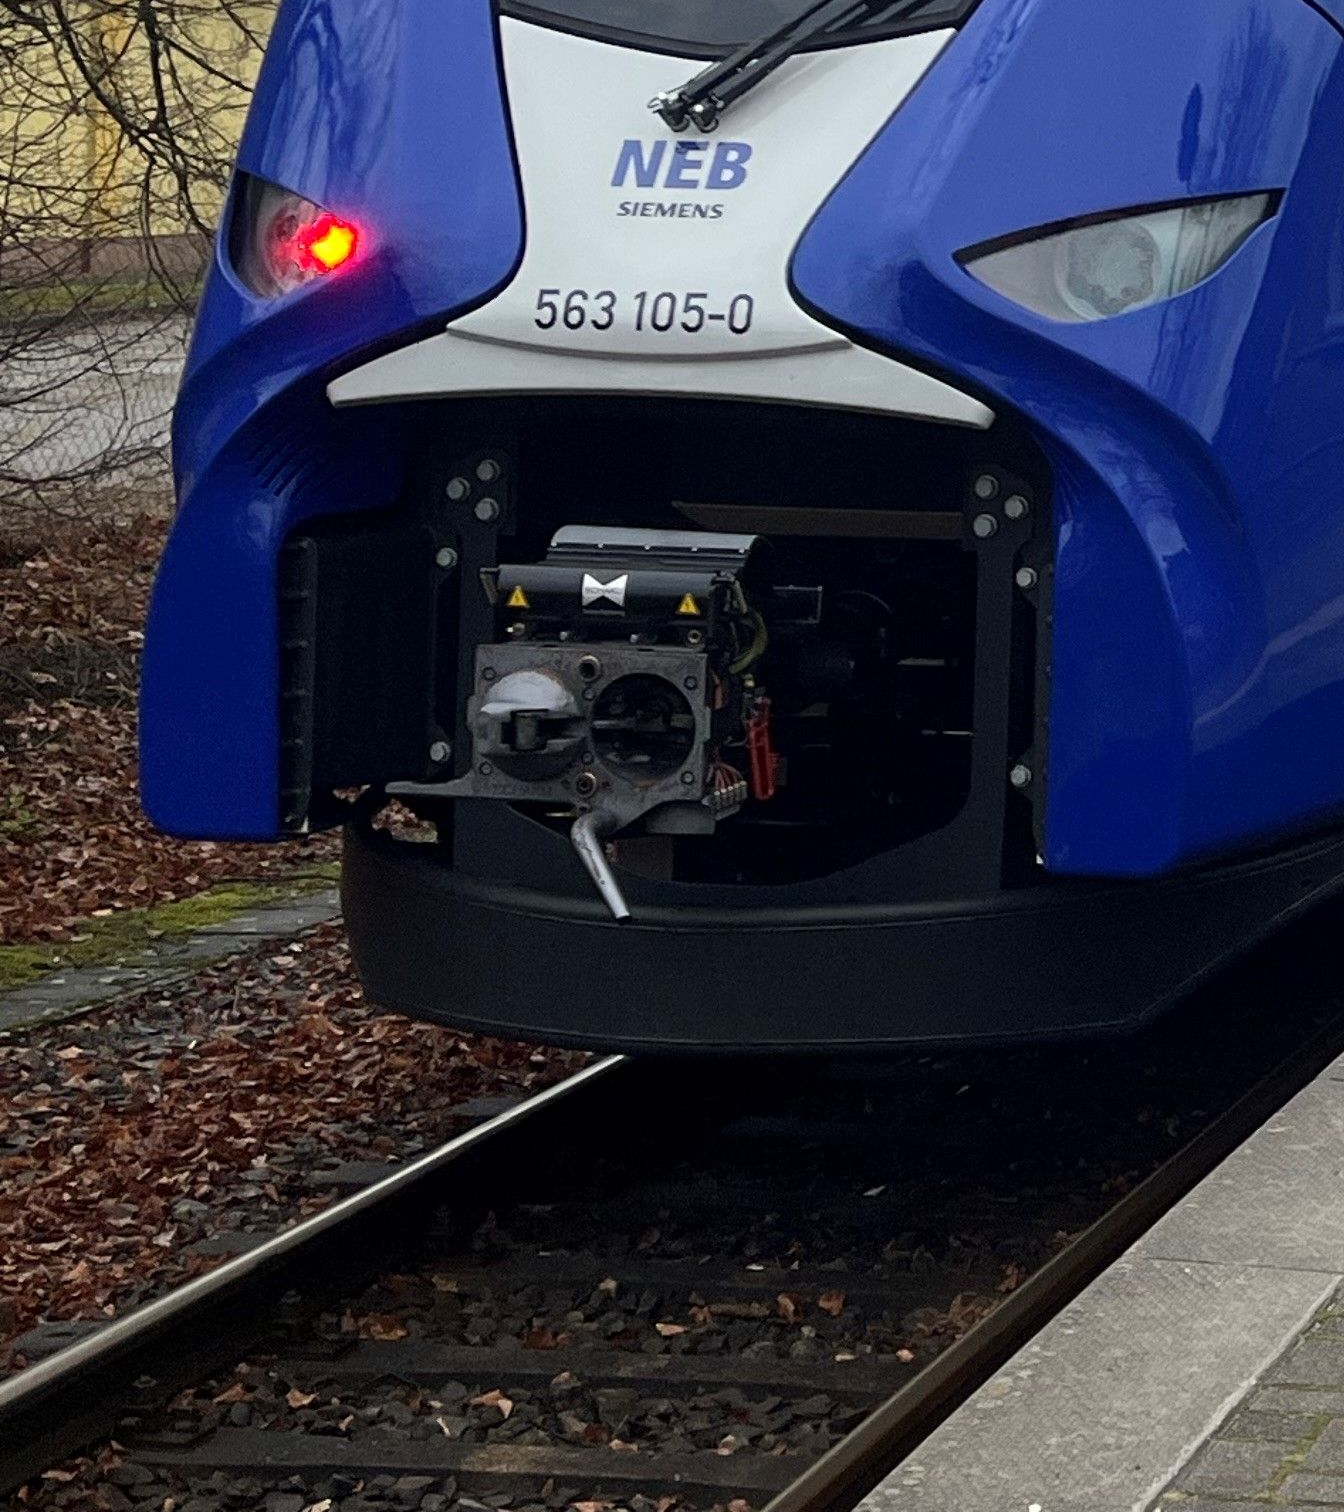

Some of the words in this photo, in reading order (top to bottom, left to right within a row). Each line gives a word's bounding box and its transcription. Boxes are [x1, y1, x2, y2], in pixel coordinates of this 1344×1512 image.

[610, 139, 753, 189] NEB
[617, 201, 724, 219] SIEMENS
[534, 288, 616, 331] 563
[634, 291, 754, 335] 105-0
